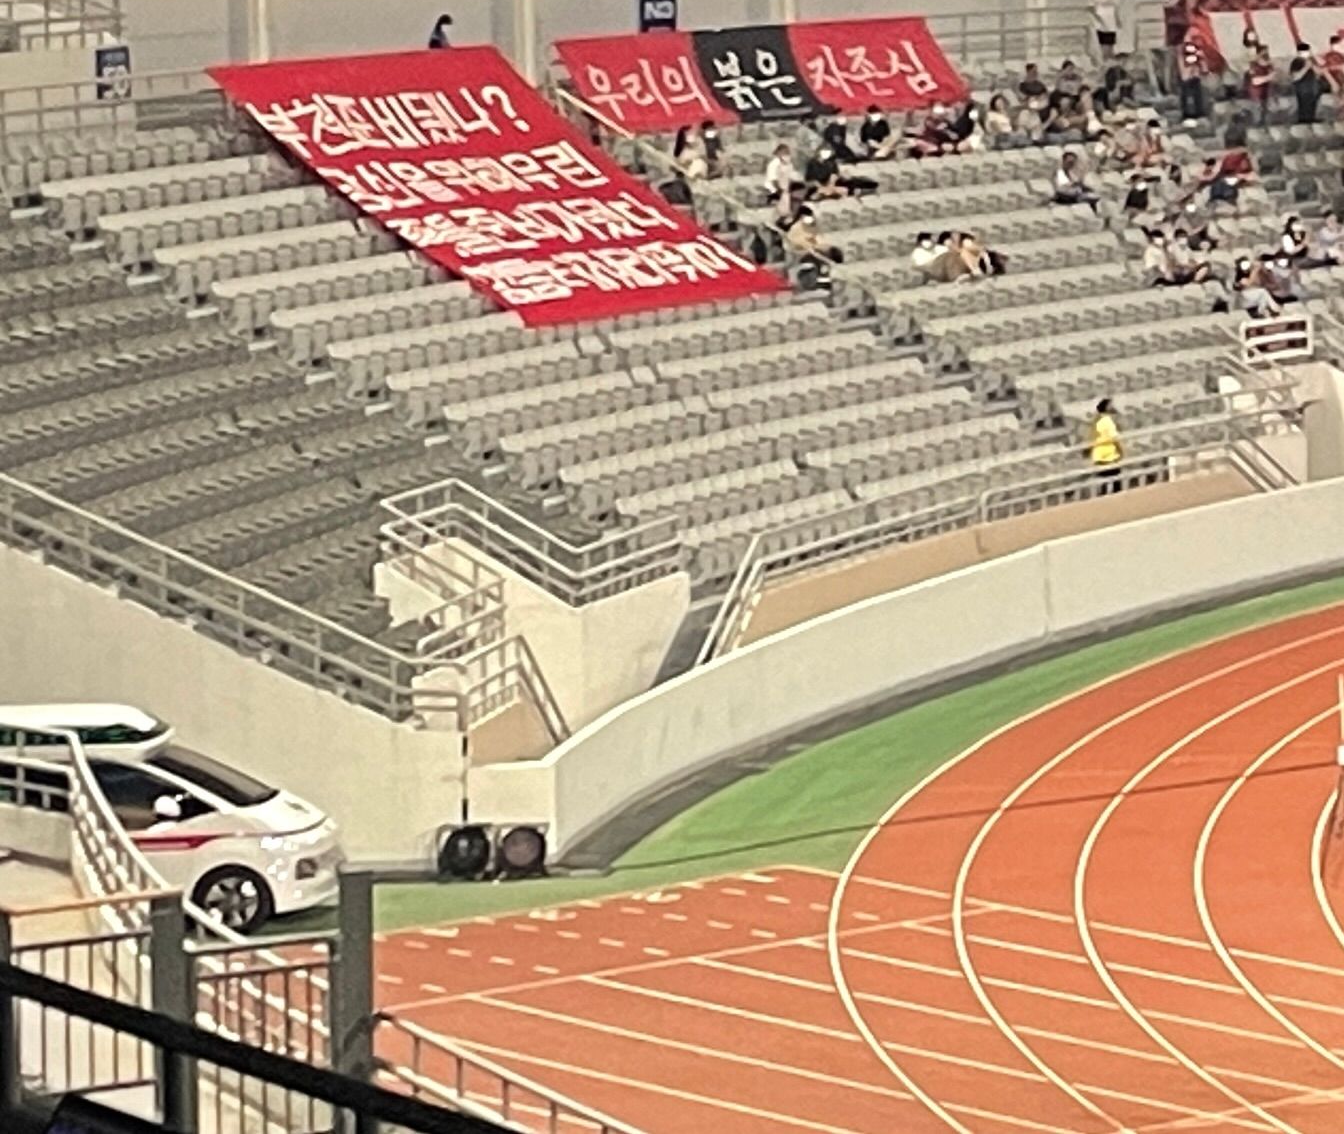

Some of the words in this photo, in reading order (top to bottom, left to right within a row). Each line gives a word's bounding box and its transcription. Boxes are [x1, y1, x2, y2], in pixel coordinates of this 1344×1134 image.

[587, 55, 713, 121] 우리의
[712, 48, 803, 111] 붉은
[806, 40, 939, 98] 자존심
